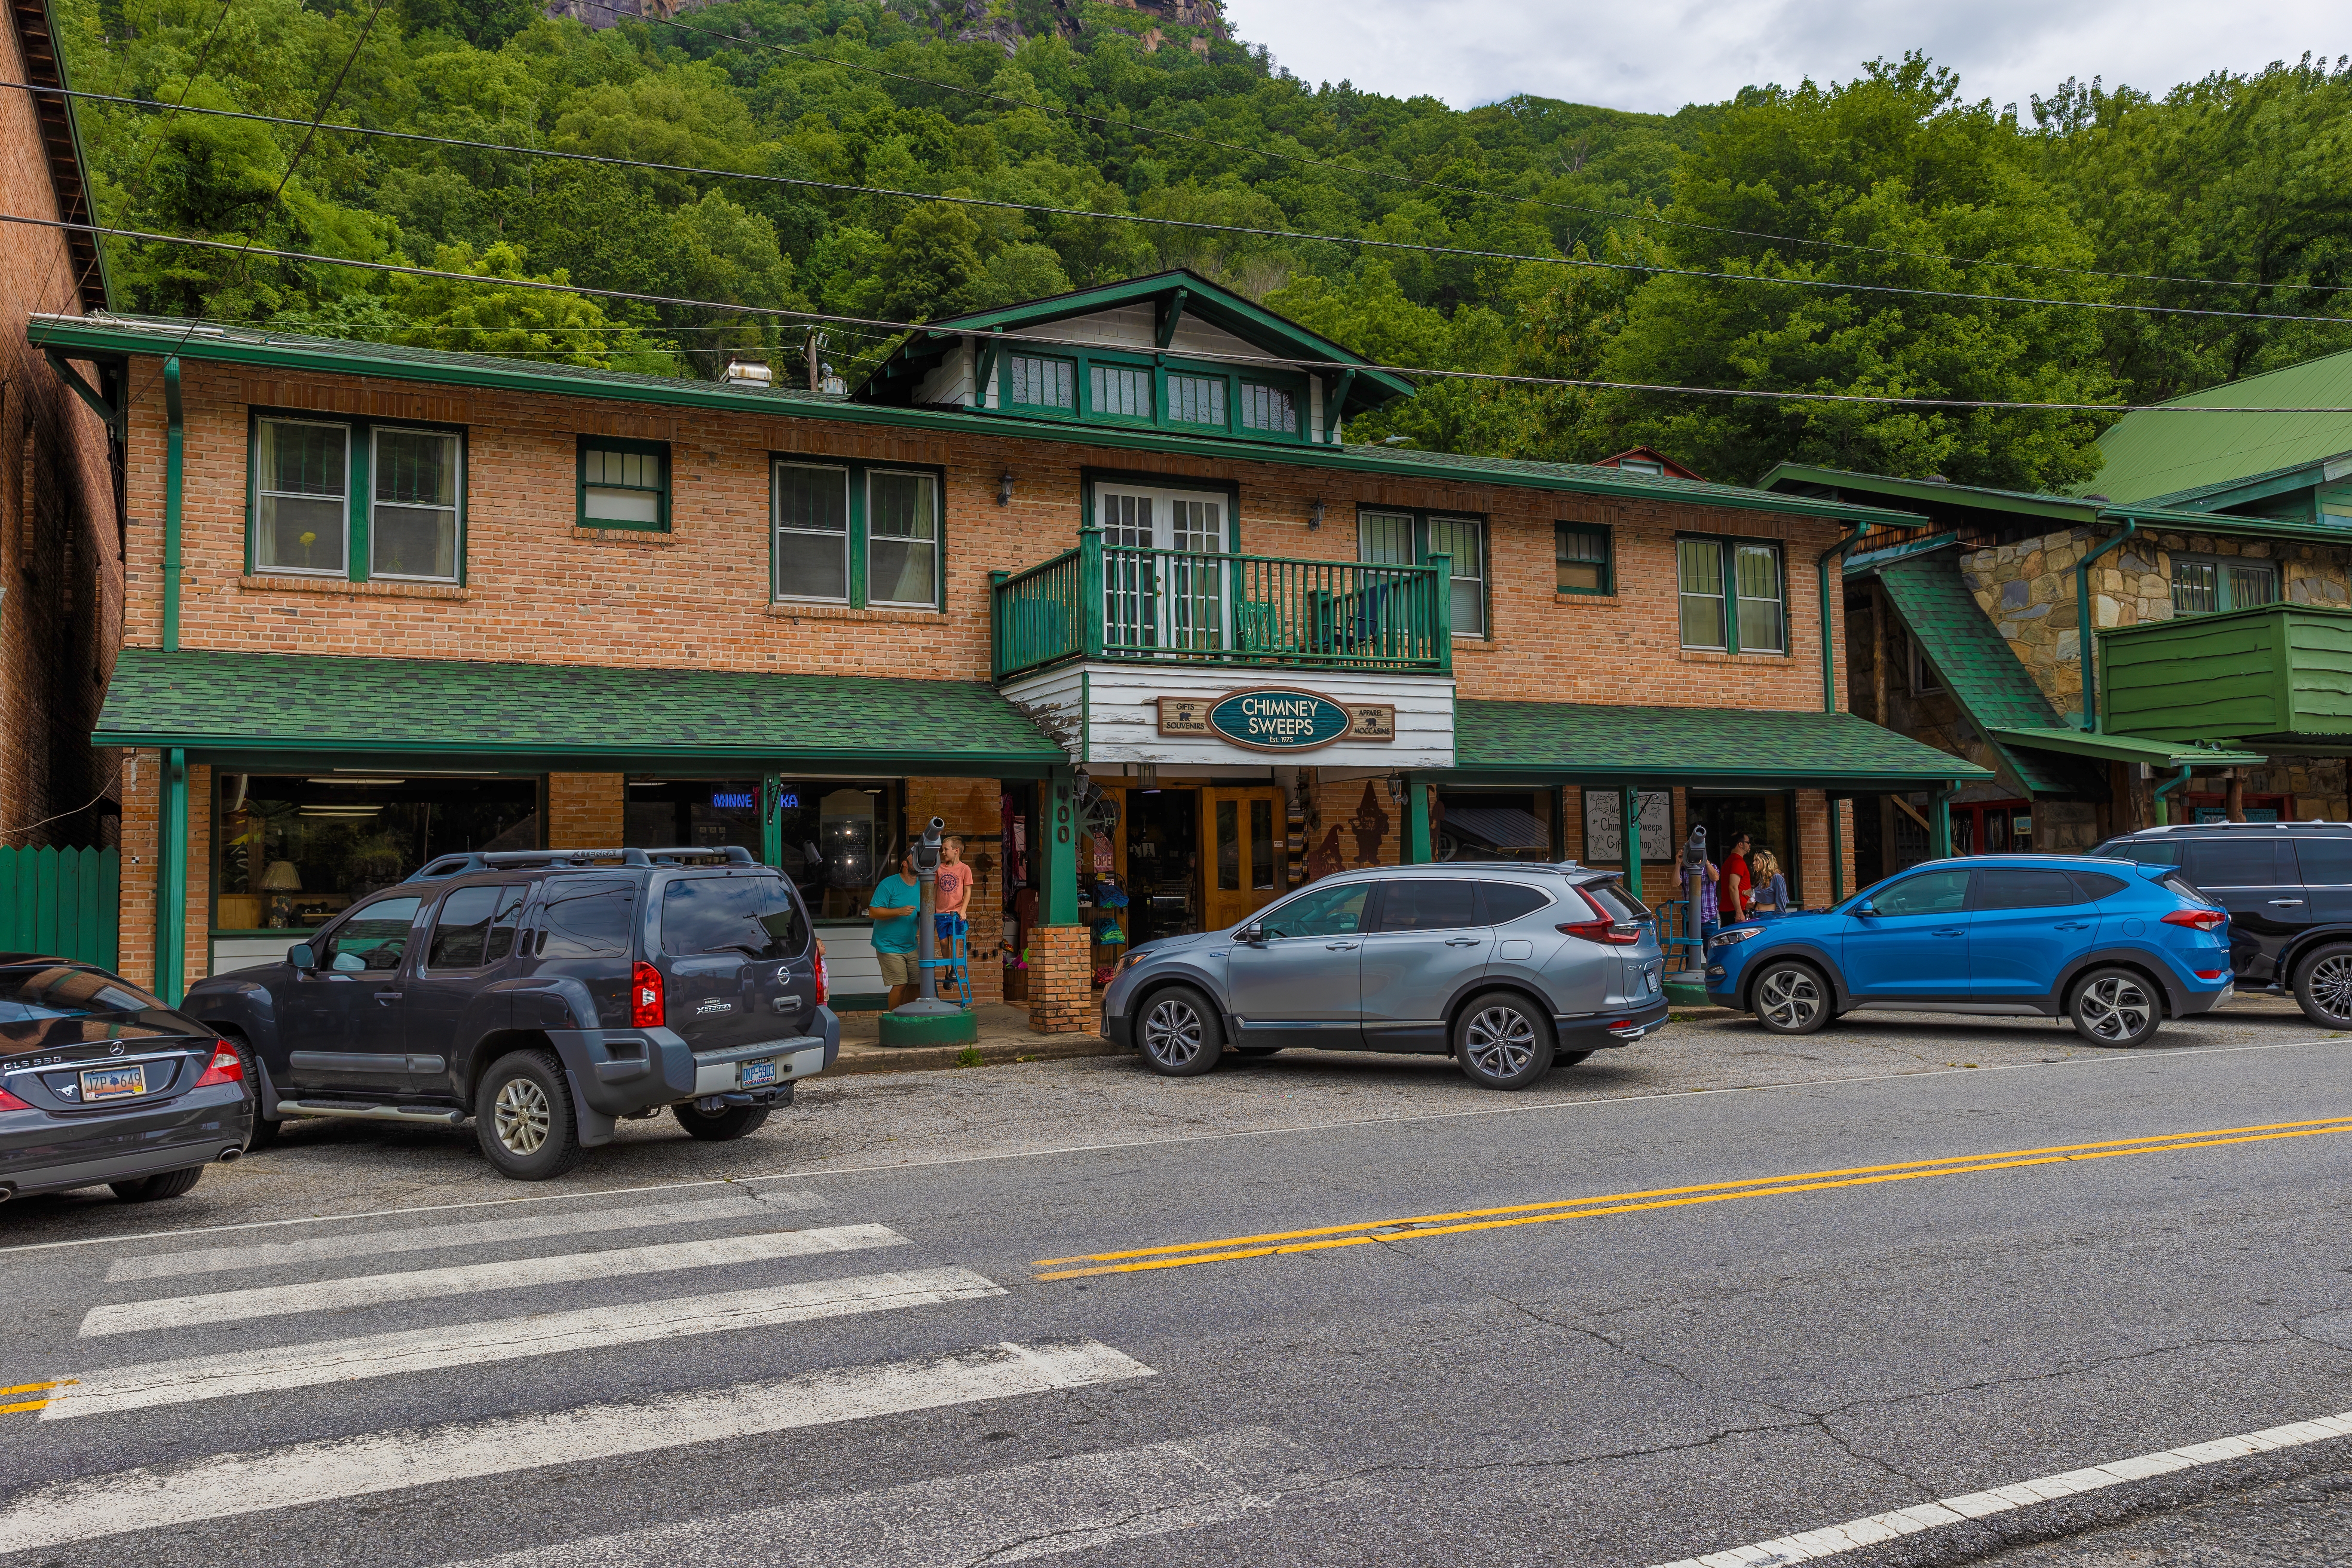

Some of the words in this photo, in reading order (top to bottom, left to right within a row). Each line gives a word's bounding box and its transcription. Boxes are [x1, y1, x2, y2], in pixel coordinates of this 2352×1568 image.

[1242, 698, 1319, 717] CHIMNEY
[1166, 722, 1204, 730] SOUVENIRS
[1248, 718, 1314, 735] SWEEPS
[1354, 727, 1390, 735] MOCCASINS
[1601, 818, 1620, 831] Chim
[1607, 835, 1621, 852] Gif
[1640, 835, 1651, 853] hop
[4, 1060, 30, 1070] CLS
[34, 1056, 61, 1066] 550
[743, 1063, 775, 1081] DKP-5903
[87, 1076, 107, 1091] JZP
[121, 1072, 141, 1087] 649
